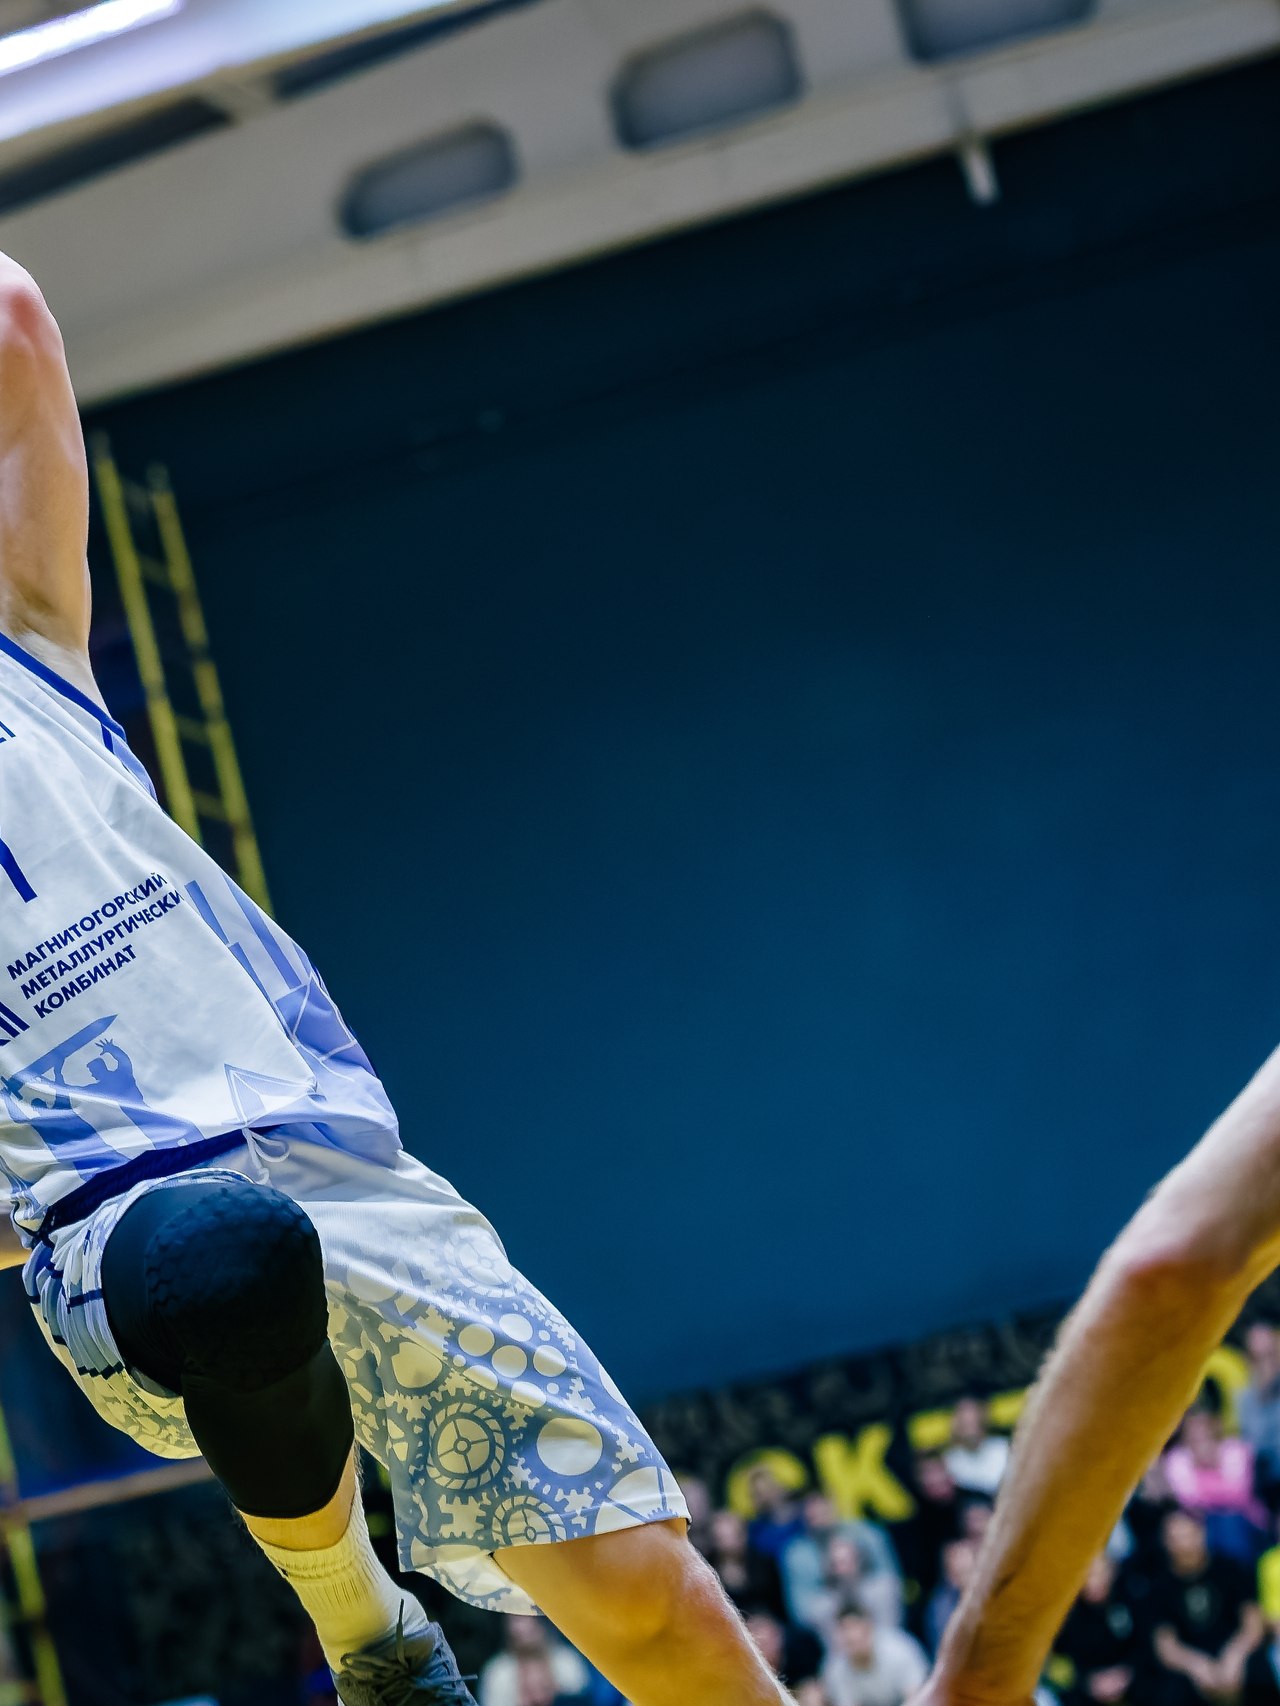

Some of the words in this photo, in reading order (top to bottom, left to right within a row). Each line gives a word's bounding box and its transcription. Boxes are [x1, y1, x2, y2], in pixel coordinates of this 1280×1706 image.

[6, 872, 168, 981] МАГНИТОГОРСКИЙ
[20, 889, 185, 1000] МЕТАЛЛУРГИЧЕСКИ
[32, 944, 138, 1019] КОМБИНАТ
